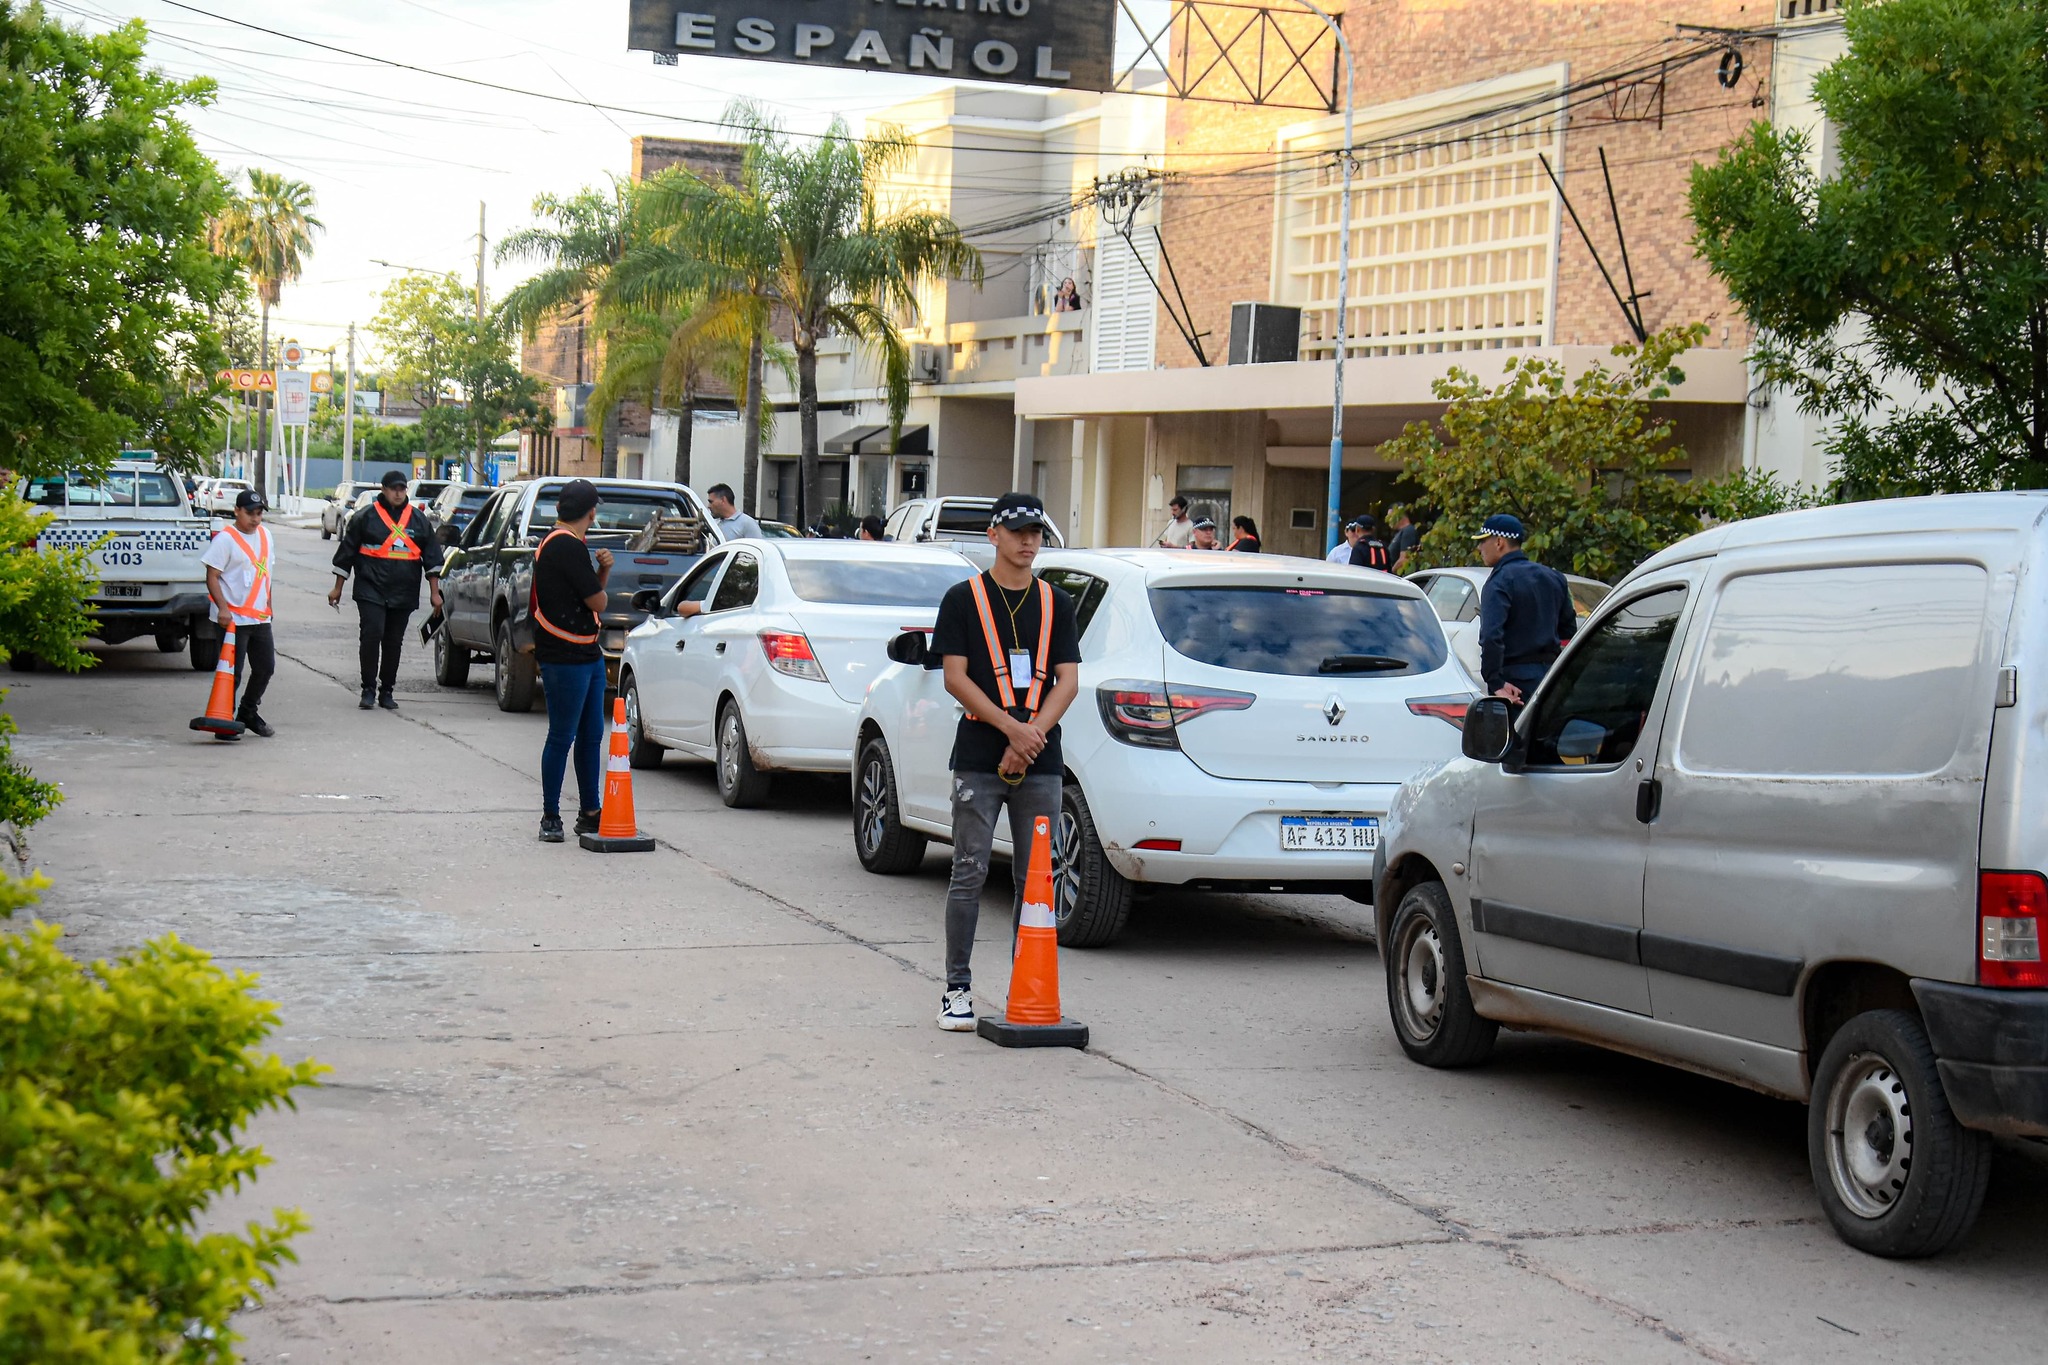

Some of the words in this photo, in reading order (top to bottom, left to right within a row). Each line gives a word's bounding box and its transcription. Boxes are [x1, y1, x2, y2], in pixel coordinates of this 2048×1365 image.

[873, 0, 1030, 17] TRO
[675, 12, 1071, 81] ESPAÑOL
[48, 541, 131, 551] NSPEION
[136, 541, 199, 551] GENERAL
[110, 552, 143, 566] 103
[125, 586, 141, 596] 677
[1296, 734, 1370, 743] SANDERO
[1287, 826, 1307, 846] AF
[1314, 827, 1347, 846] 413
[1352, 828, 1375, 847] HU
